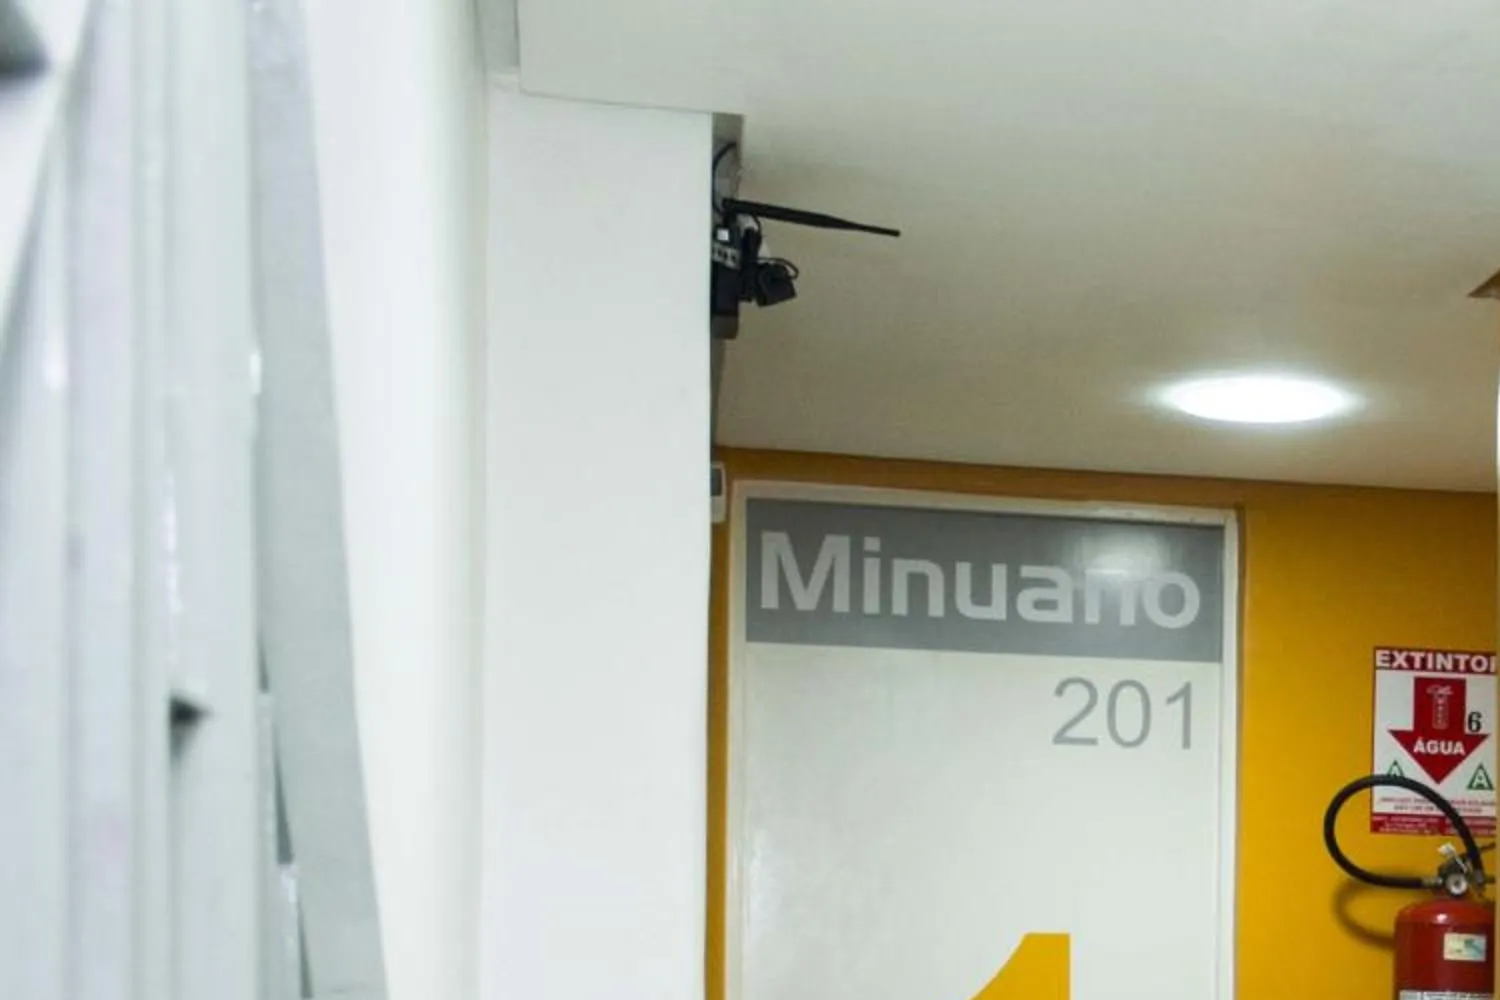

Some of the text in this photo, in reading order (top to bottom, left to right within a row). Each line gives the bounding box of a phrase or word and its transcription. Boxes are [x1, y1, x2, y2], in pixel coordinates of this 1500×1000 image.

[760, 530, 1200, 629] Minuano
[1052, 676, 1193, 750] 201
[1467, 711, 1482, 732] 6
[1413, 736, 1465, 756] ÁGUA
